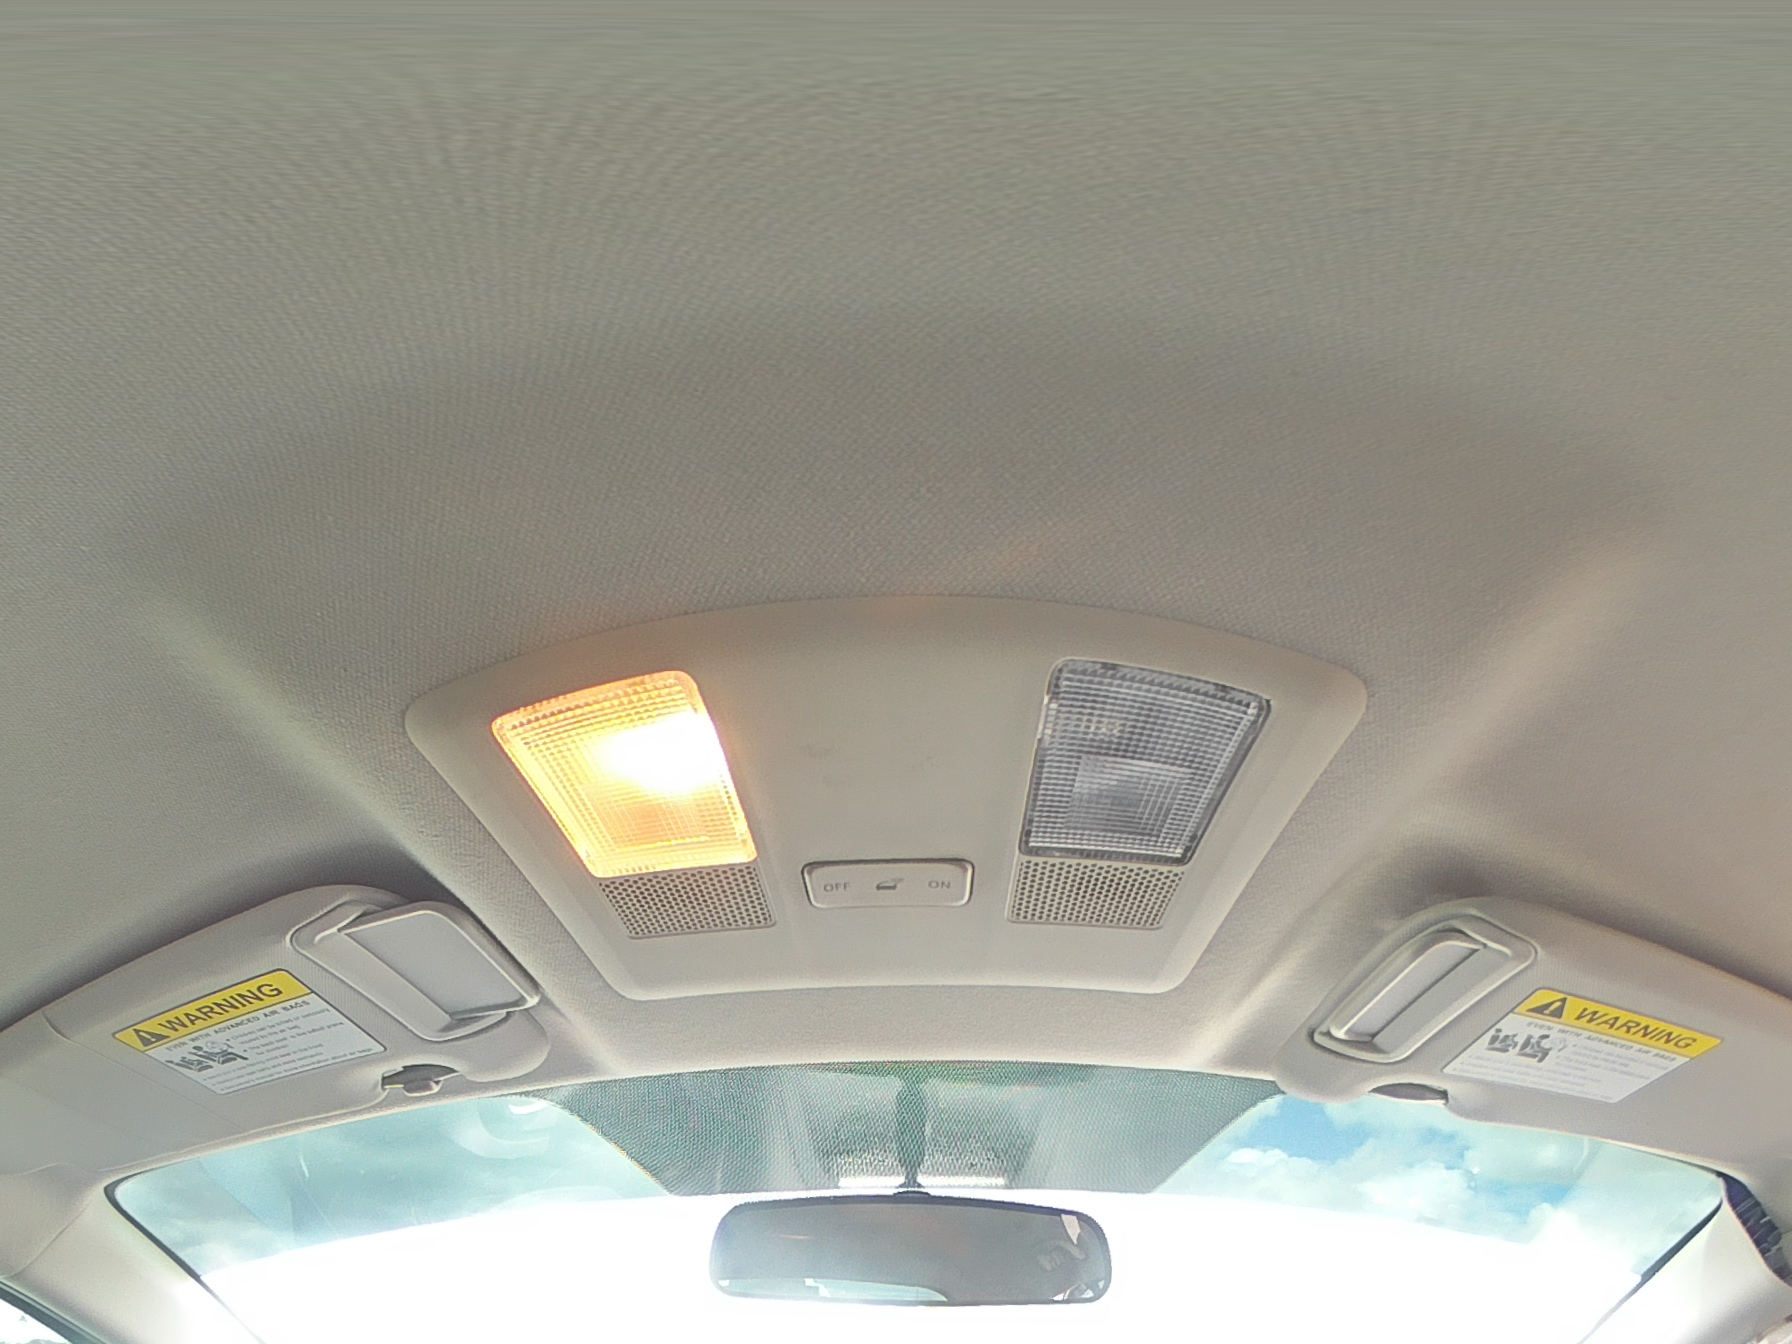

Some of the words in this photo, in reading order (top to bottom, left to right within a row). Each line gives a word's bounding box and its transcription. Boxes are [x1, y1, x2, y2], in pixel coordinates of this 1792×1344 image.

[823, 883, 850, 892] OFF
[928, 880, 951, 889] ON
[159, 983, 281, 1031] WARNING
[188, 1032, 211, 1042] WITH
[213, 1016, 259, 1034] ADVANCED
[262, 1009, 279, 1017] AIR
[280, 1000, 310, 1011] BAGS
[1575, 1008, 1696, 1048] WARNING
[1584, 1035, 1633, 1050] ADVANCED
